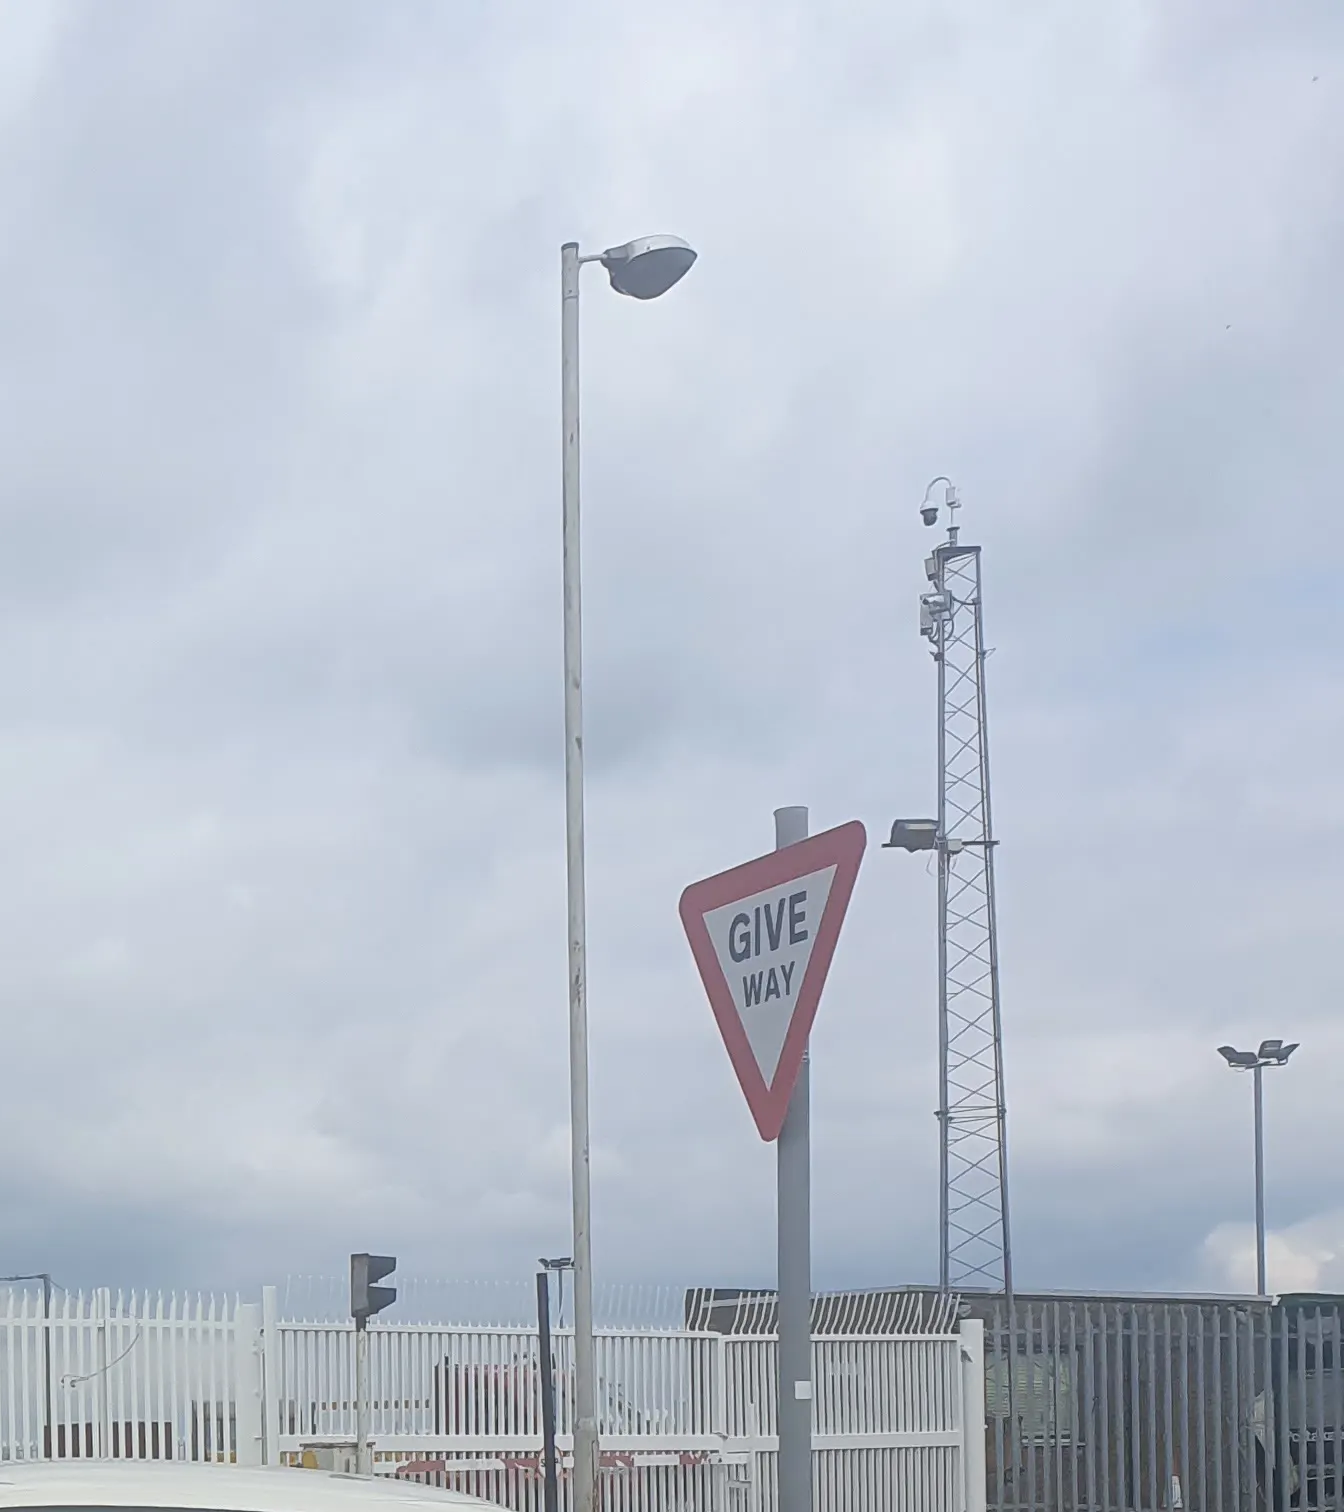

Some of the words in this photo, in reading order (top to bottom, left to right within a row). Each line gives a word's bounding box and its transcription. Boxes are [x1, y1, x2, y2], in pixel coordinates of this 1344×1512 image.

[728, 890, 809, 963] GIVE
[742, 961, 796, 1008] WAY
[540, 1457, 559, 1468] SP
